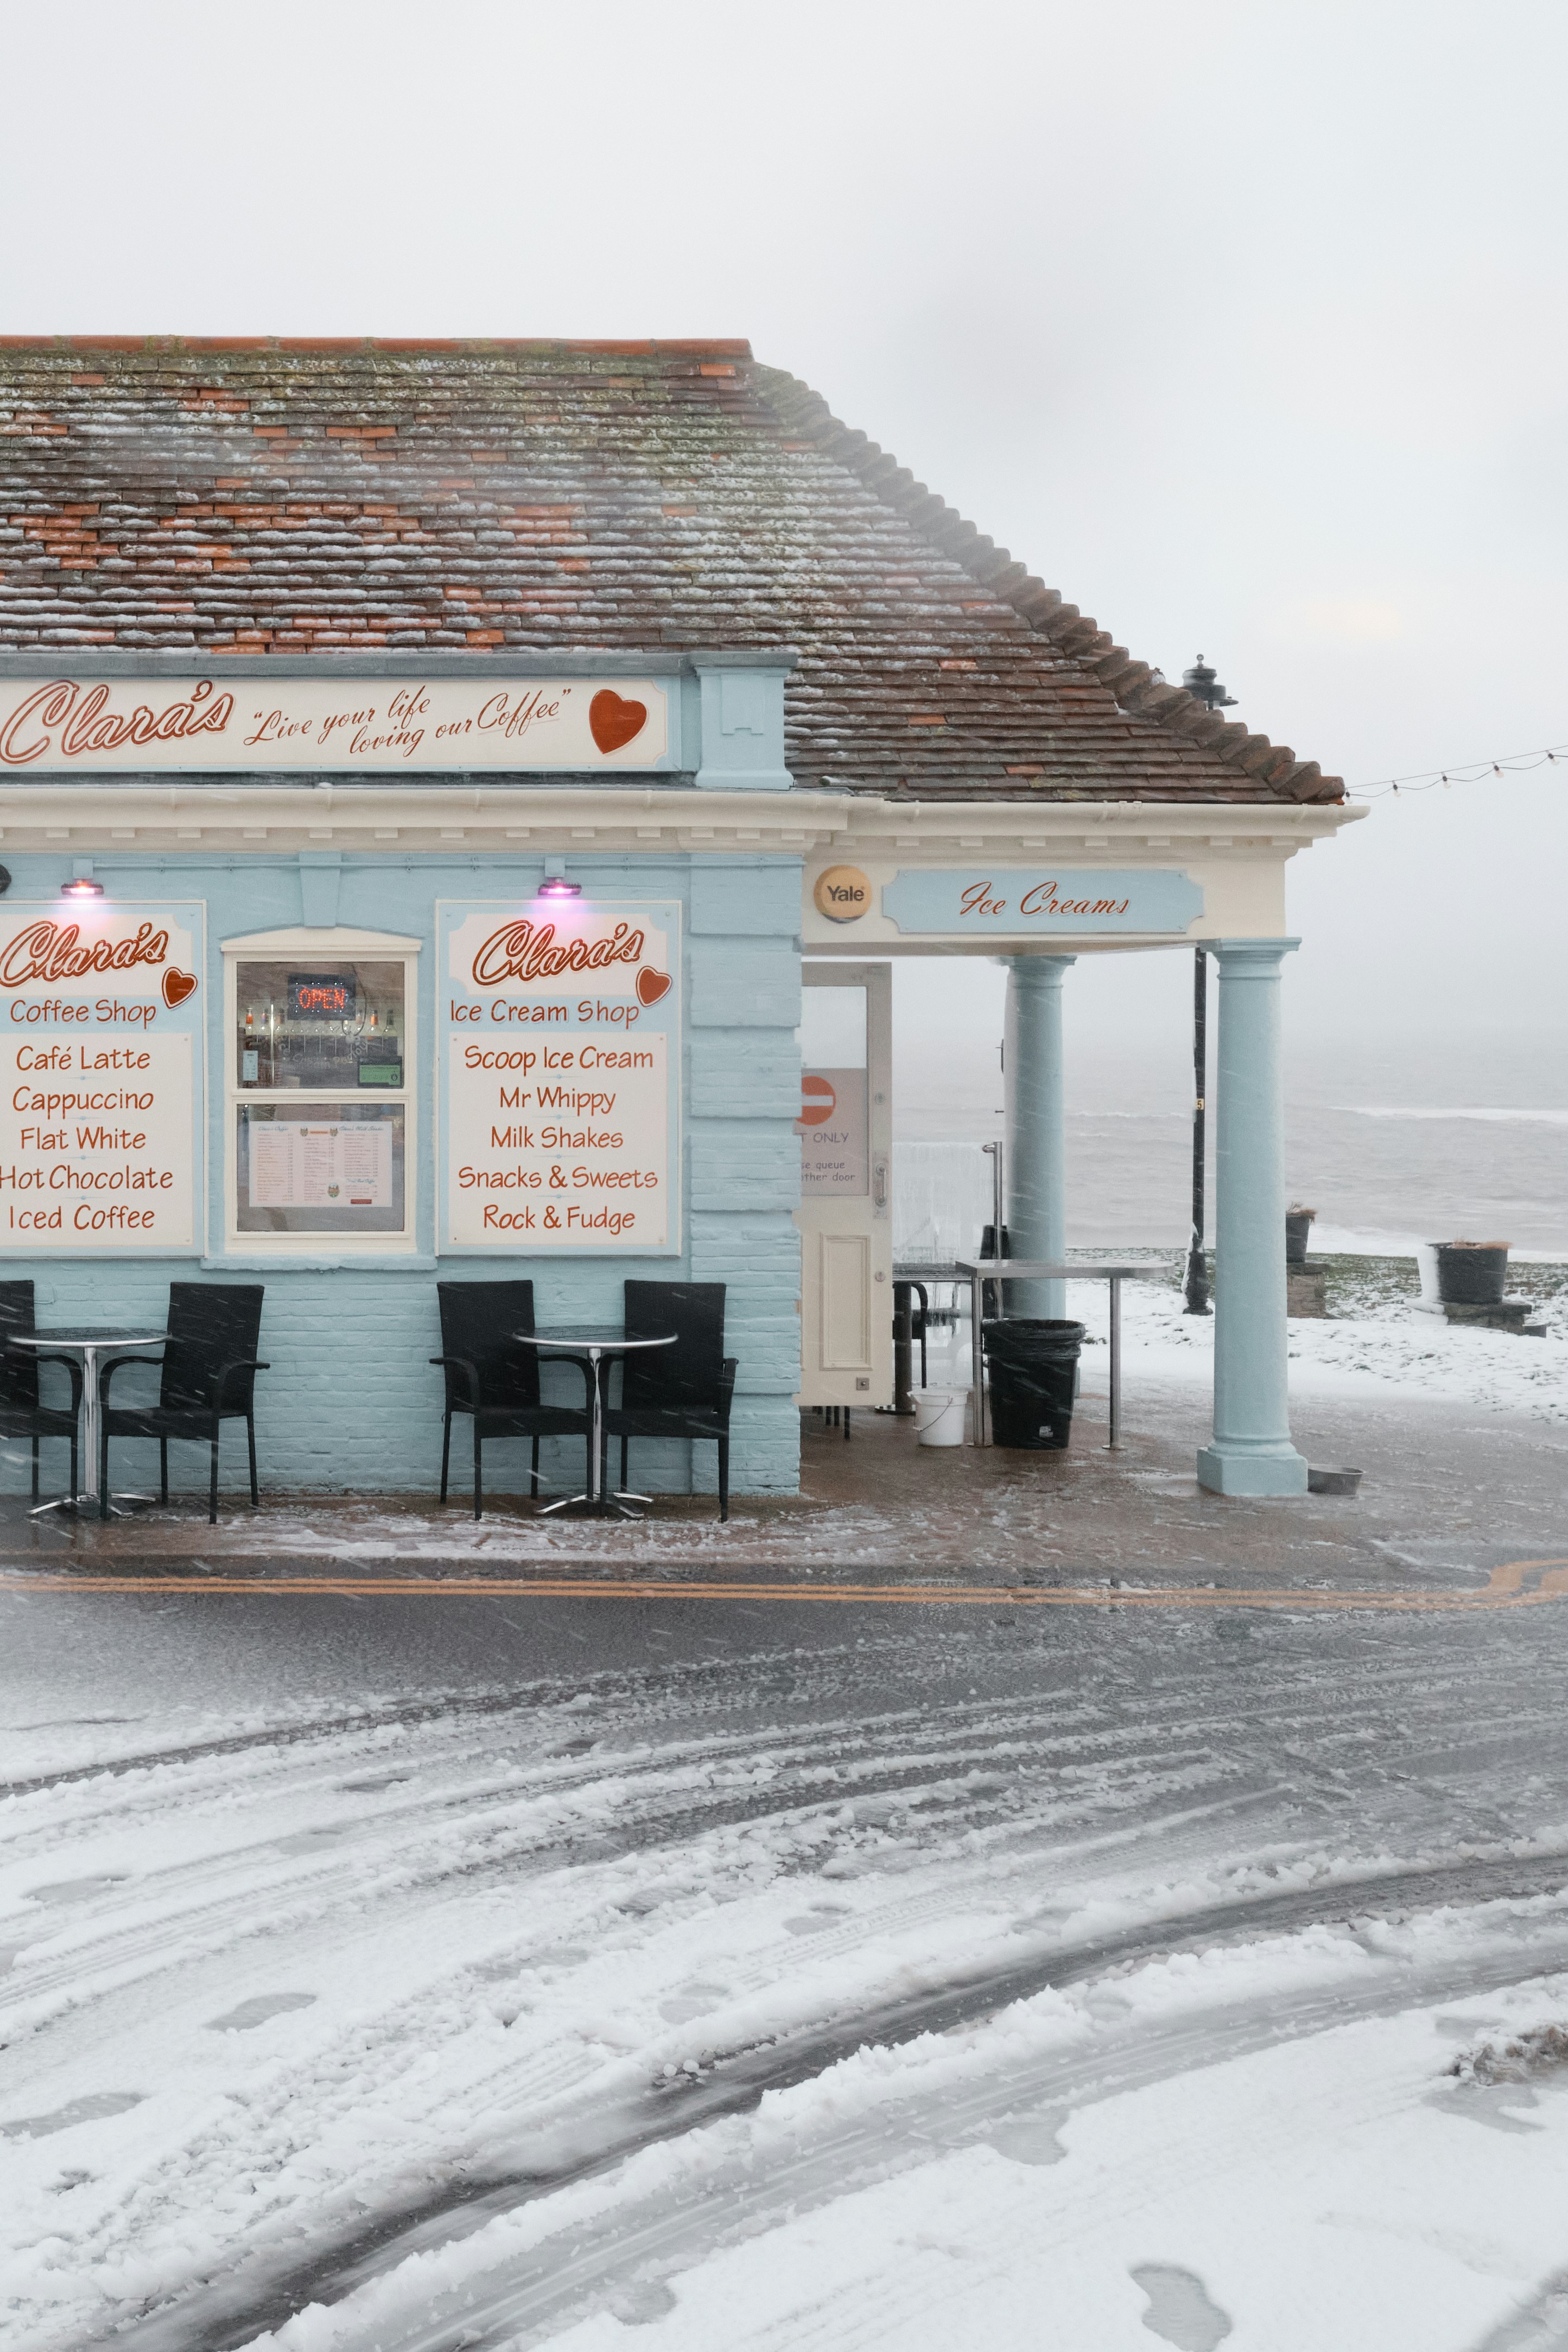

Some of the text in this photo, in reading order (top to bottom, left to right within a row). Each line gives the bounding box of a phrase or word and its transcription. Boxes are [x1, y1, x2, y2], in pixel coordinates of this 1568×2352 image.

[0, 680, 233, 764] Clara's
[318, 708, 375, 744] your
[388, 685, 431, 728] life
[350, 725, 426, 757] loving
[435, 719, 472, 738] our
[827, 886, 864, 901] Yale
[960, 882, 1128, 915] Ice Creams
[0, 920, 169, 987] Clara's
[472, 920, 645, 986] Clara's
[299, 988, 346, 1009] OPEN
[10, 999, 156, 1029] Coffee Shop
[452, 999, 639, 1030] Ice Cream Shop
[17, 1045, 150, 1070] Café Latte
[465, 1045, 653, 1076] Scoop Ice Cream
[13, 1086, 154, 1120] Cappuccino
[500, 1086, 615, 1116] Mr Whippy
[21, 1127, 145, 1150] Flat White
[492, 1126, 623, 1148] Milk Shakes
[813, 1132, 849, 1143] ONLY
[0, 1165, 173, 1189] Hot Chocolate
[459, 1165, 657, 1188] Snacks & Sweets
[816, 1162, 846, 1171] queue
[832, 1172, 855, 1182] door
[10, 1204, 155, 1230] Iced Coffee
[484, 1204, 636, 1235] Rock & Fudge
